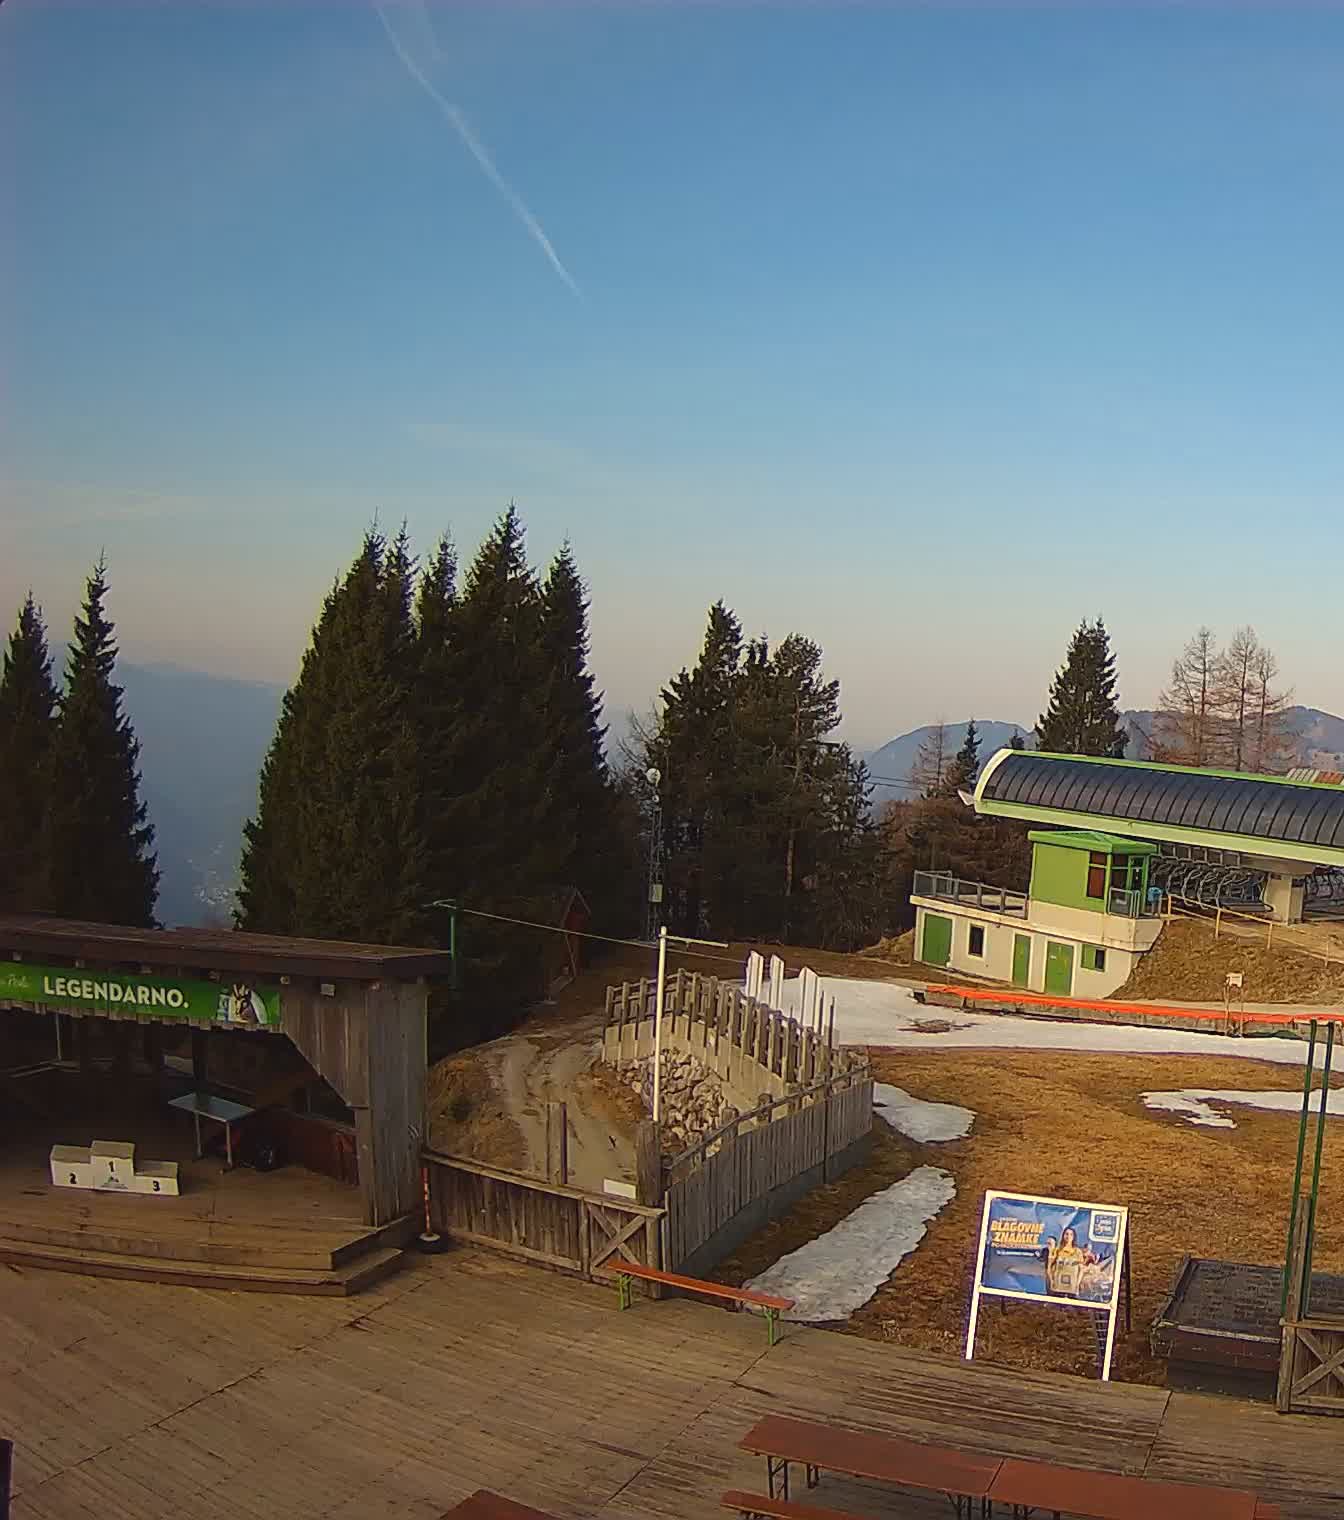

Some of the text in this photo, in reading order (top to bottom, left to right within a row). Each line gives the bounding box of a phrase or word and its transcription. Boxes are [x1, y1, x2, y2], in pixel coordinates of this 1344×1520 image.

[44, 976, 189, 1009] LEGENDARNO.
[108, 1161, 115, 1173] 1
[69, 1172, 77, 1185] 2
[152, 1180, 161, 1192] 3
[991, 1220, 1046, 1234] BLAGOVNE
[993, 1232, 1041, 1245] ZNAMKE
